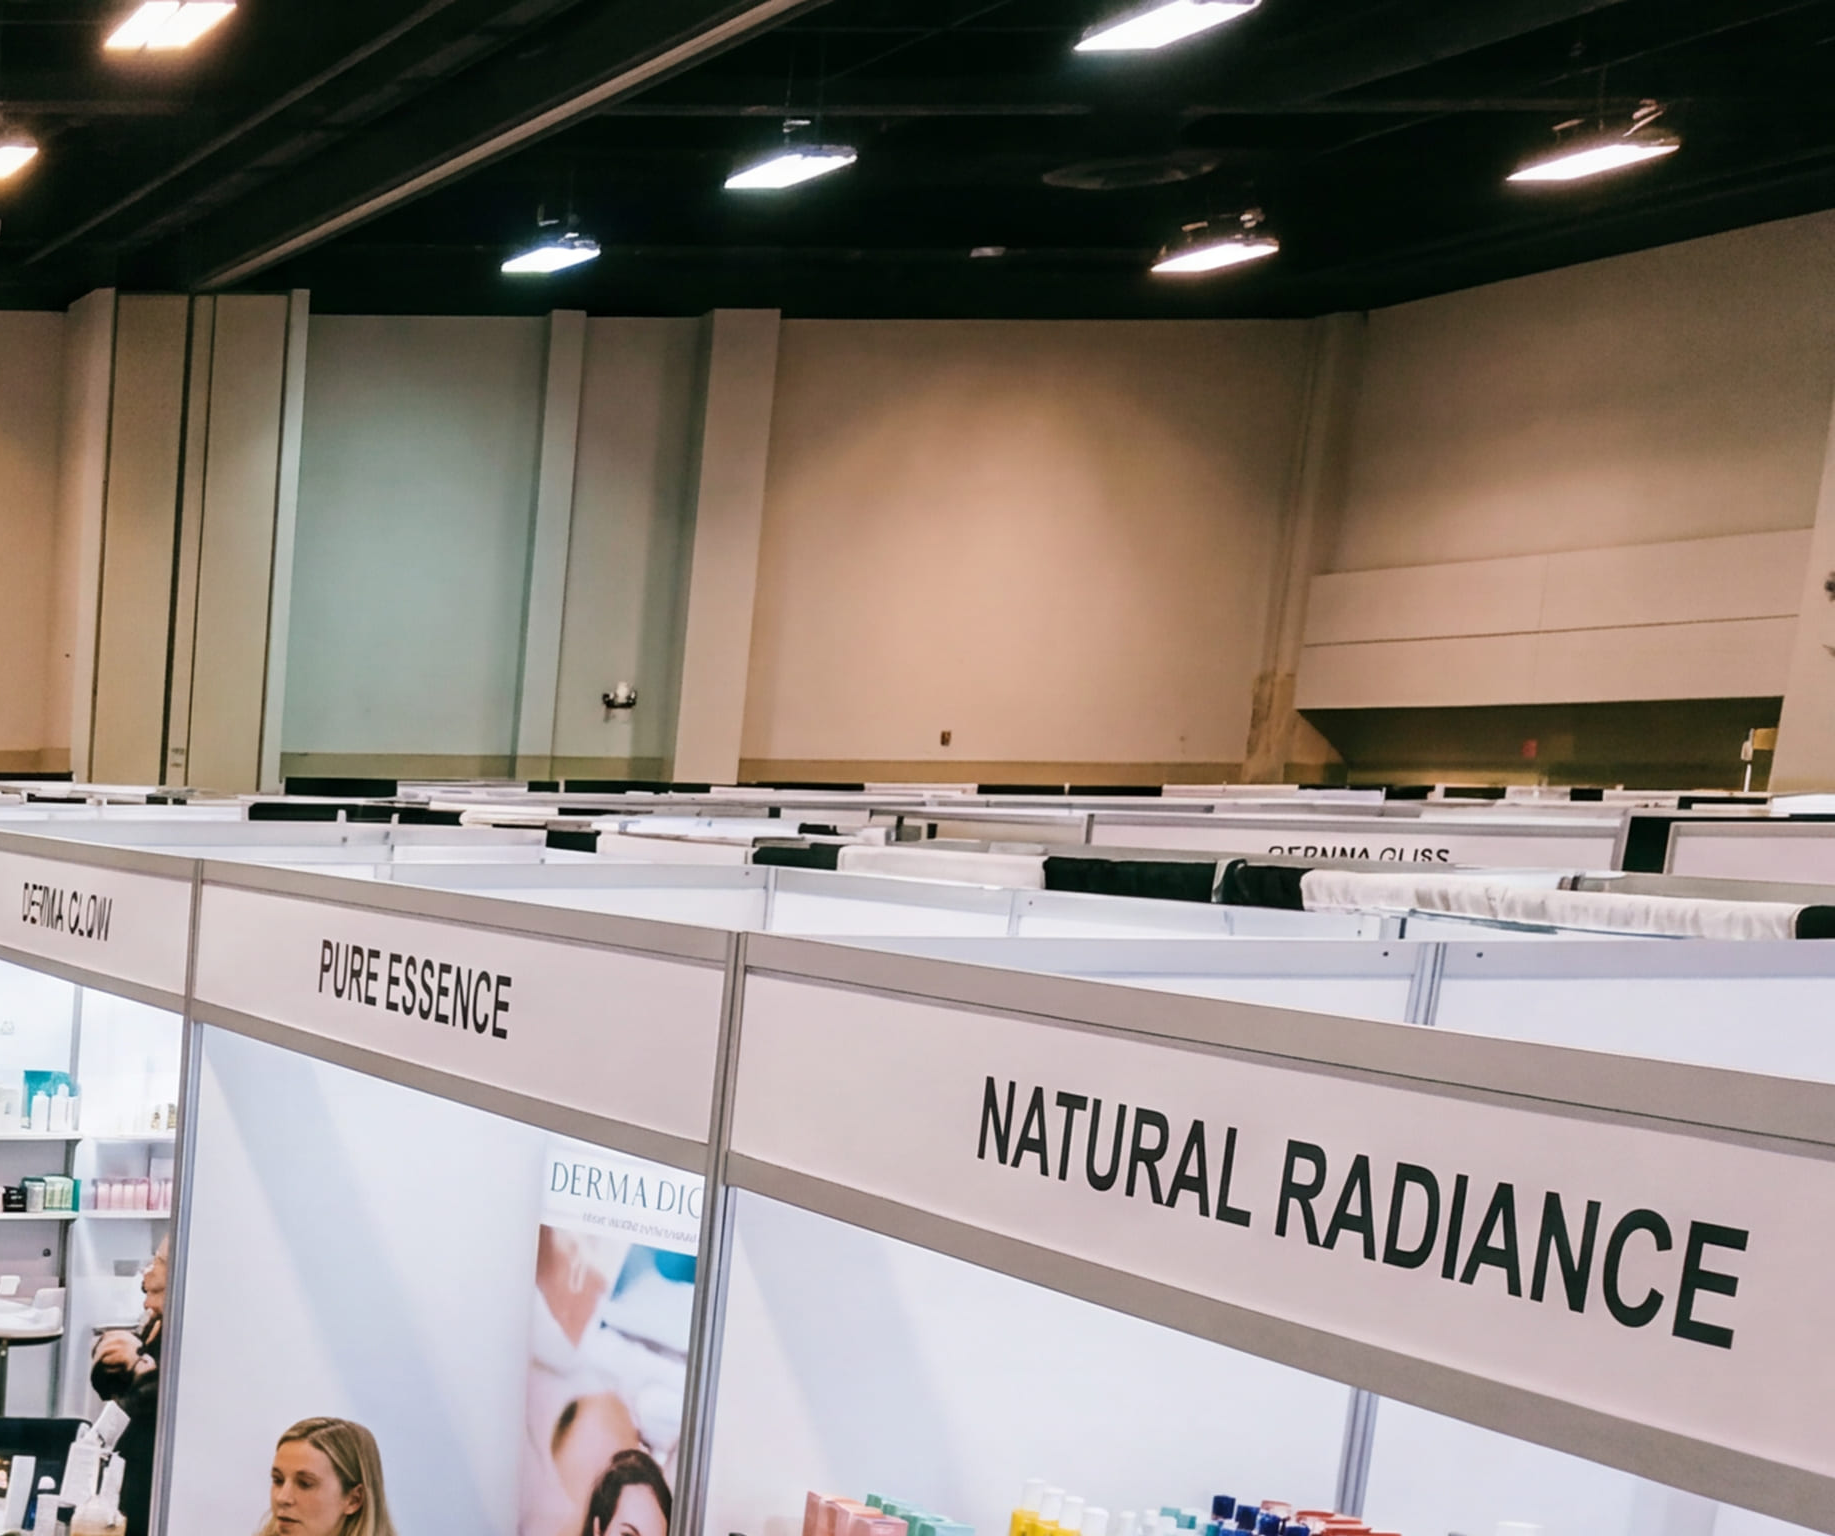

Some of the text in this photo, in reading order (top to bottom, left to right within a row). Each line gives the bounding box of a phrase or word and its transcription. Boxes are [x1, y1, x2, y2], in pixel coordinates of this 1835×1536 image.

[318, 939, 512, 1040] PURE ESSENCE
[550, 1162, 647, 1208] DERMA
[977, 1076, 1750, 1350] NATURAL RADIANCE
